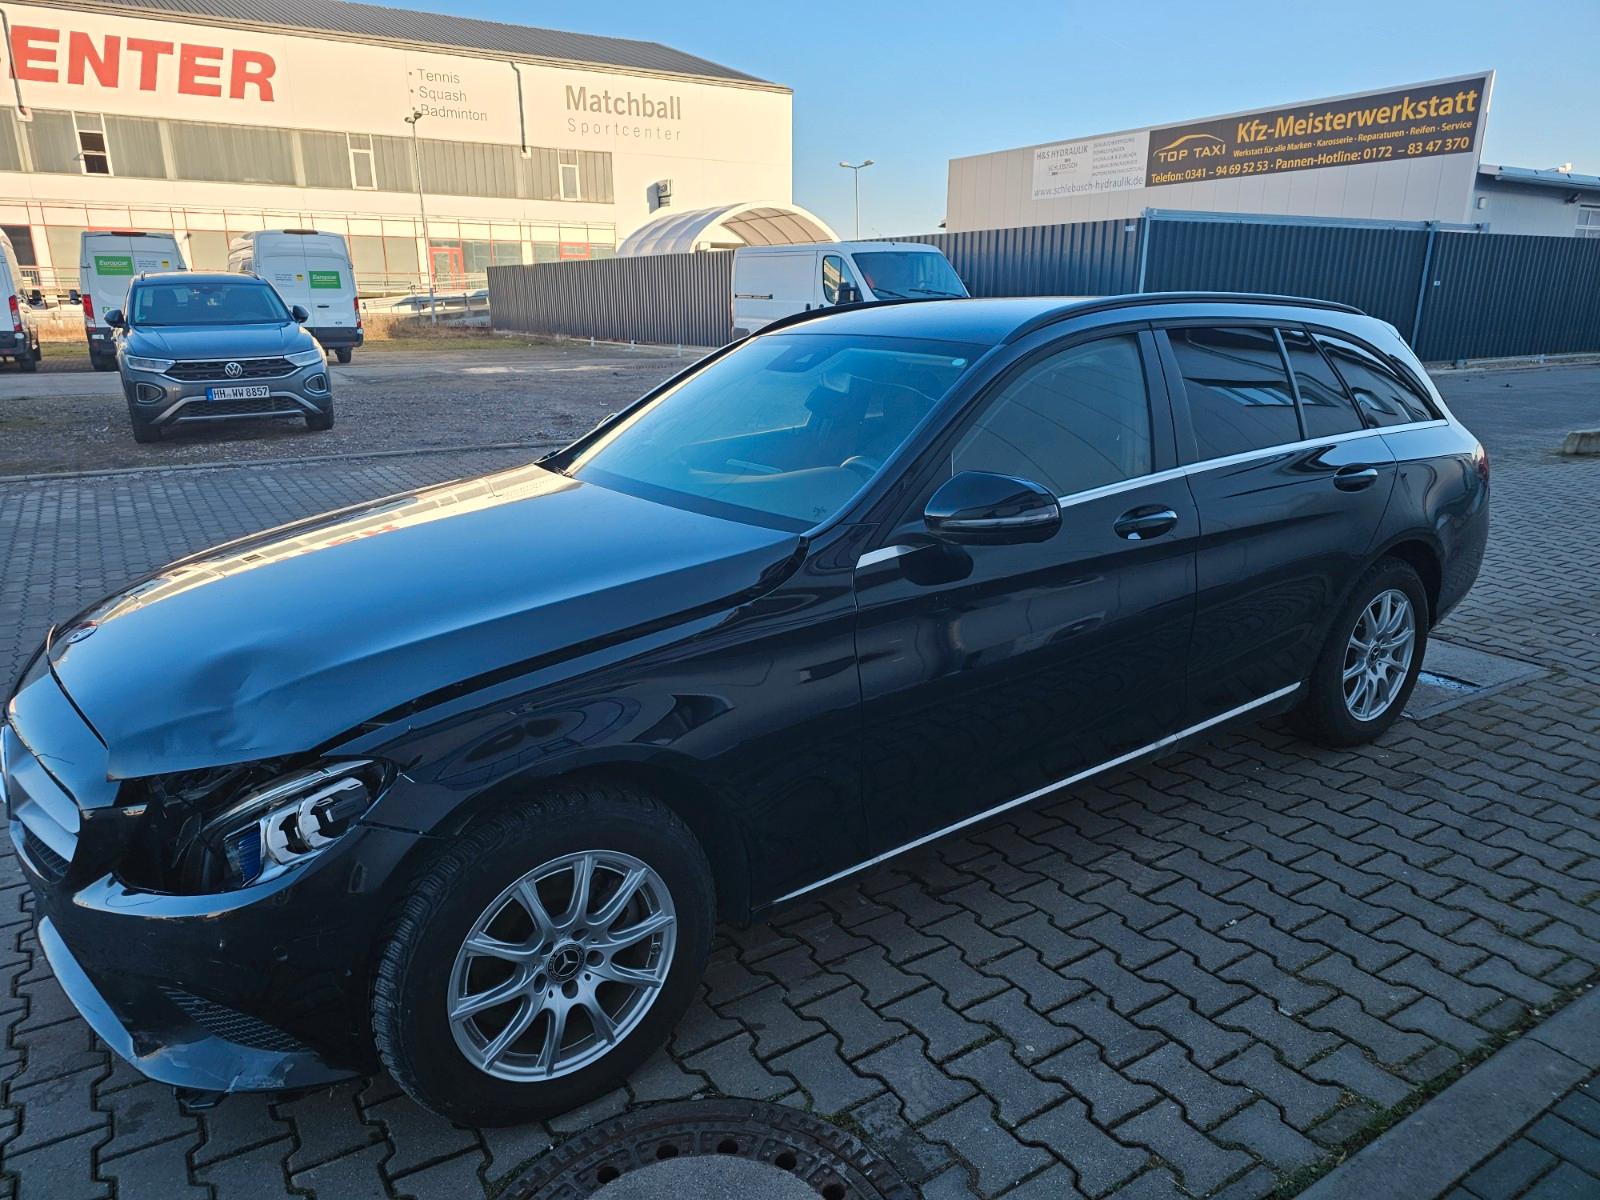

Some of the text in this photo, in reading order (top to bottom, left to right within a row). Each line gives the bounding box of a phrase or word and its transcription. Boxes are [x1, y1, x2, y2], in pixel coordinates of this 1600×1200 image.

[9, 25, 276, 102] ENTER
[417, 68, 460, 84] Tennis
[419, 86, 467, 102] Squash
[565, 85, 681, 120] Matchball
[421, 104, 487, 121] Badminton
[1236, 90, 1478, 143] Kfz-Meisterwerkstatt
[567, 117, 681, 140] Sportcenter
[1233, 120, 1472, 158] Werkstatt für alle Marken Karosserie Reparaturen Reifen Service
[1050, 145, 1088, 159] HYDRAULIK
[1151, 171, 1184, 183] Telefon:
[1185, 168, 1206, 179] 0341
[1216, 165, 1227, 176] 94
[1229, 164, 1241, 174] 69
[1242, 162, 1255, 173] 52
[1257, 160, 1269, 171] 53
[1275, 151, 1361, 169] Pannen-Hotline:
[1363, 146, 1392, 160] 0172
[1407, 142, 1423, 155] 83
[1425, 140, 1442, 152] 47
[1444, 137, 1470, 151] 370
[1159, 144, 1226, 163] TOP TAXI
[213, 386, 268, 399] HH WW 8857
